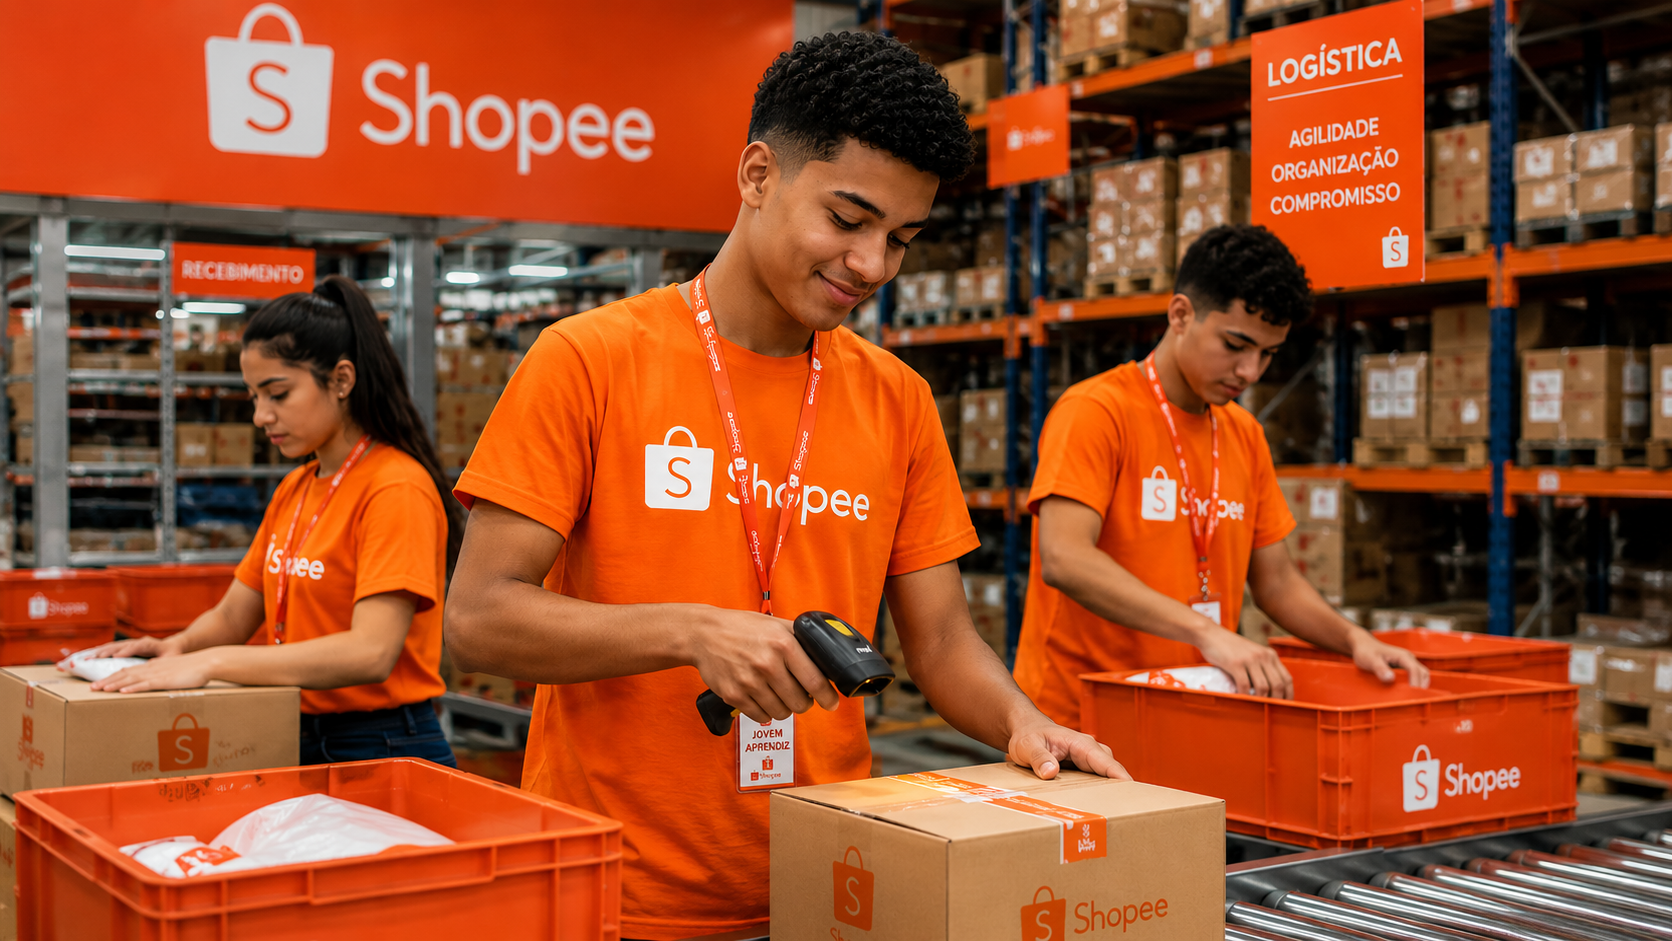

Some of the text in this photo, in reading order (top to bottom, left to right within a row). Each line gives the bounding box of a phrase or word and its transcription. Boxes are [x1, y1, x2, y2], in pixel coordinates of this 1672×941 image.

[1267, 38, 1403, 87] LOGÍSTICA
[246, 58, 655, 175] S Shopee
[1288, 117, 1380, 149] AGILIDADE
[1271, 146, 1399, 183] ORGANIZAÇÃO
[1270, 182, 1401, 215] COMPROMISSO
[181, 260, 304, 285] RECEBIMENTO
[664, 456, 692, 498] S
[1153, 486, 1167, 513] S
[174, 735, 194, 765] S
[745, 741, 790, 752] APRENDIZ
[752, 728, 783, 739] JOVEM
[1414, 762, 1521, 801] S Shopee
[845, 876, 861, 917] S
[1035, 898, 1168, 941] S Shopee
